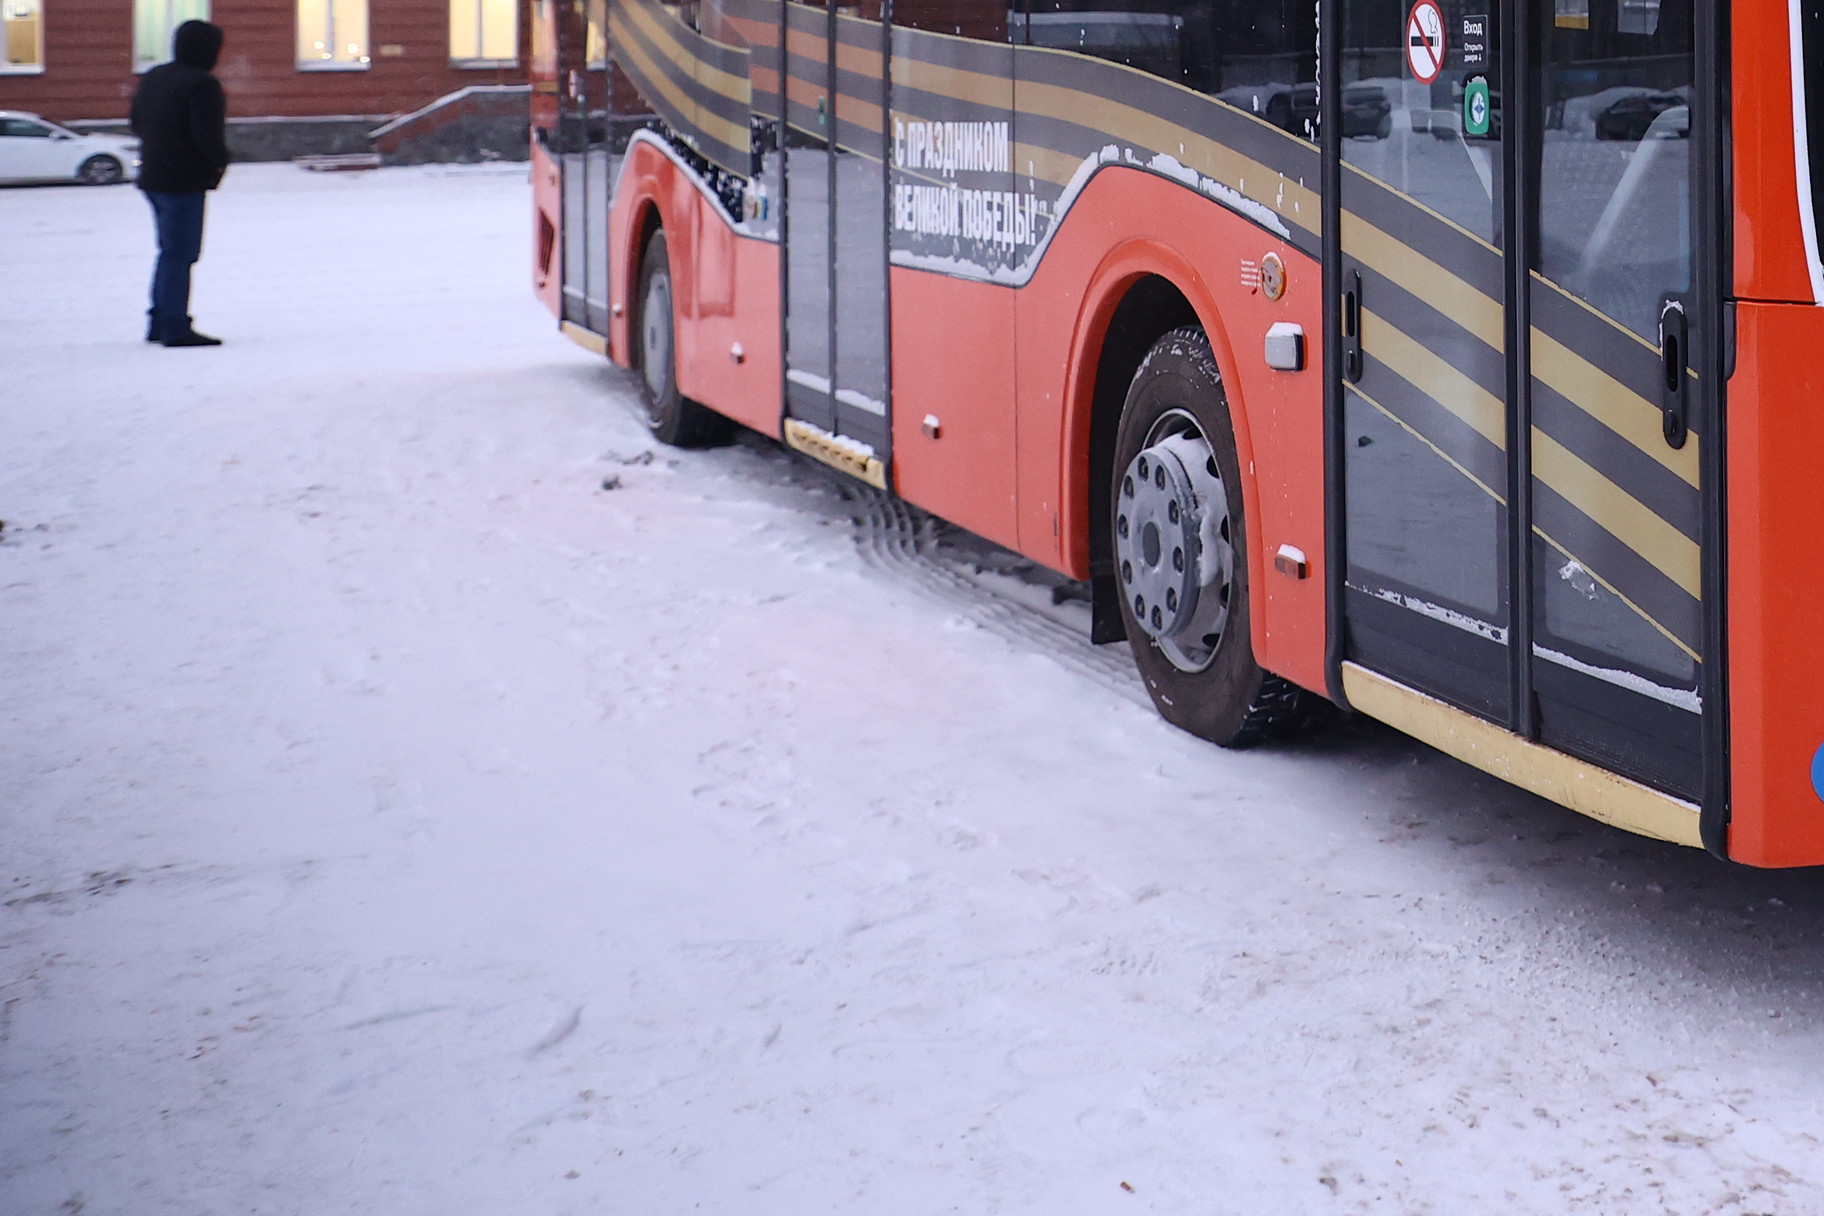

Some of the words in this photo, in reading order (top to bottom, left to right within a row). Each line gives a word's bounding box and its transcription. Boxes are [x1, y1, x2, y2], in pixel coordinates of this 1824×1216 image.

[1463, 20, 1483, 36] Вход
[895, 119, 905, 168] С
[907, 120, 1009, 178] ПРАЗДНИКОМ
[895, 183, 961, 237] ВЕЛИКОЙ
[962, 189, 1036, 253] ПОБЕДЫ!
